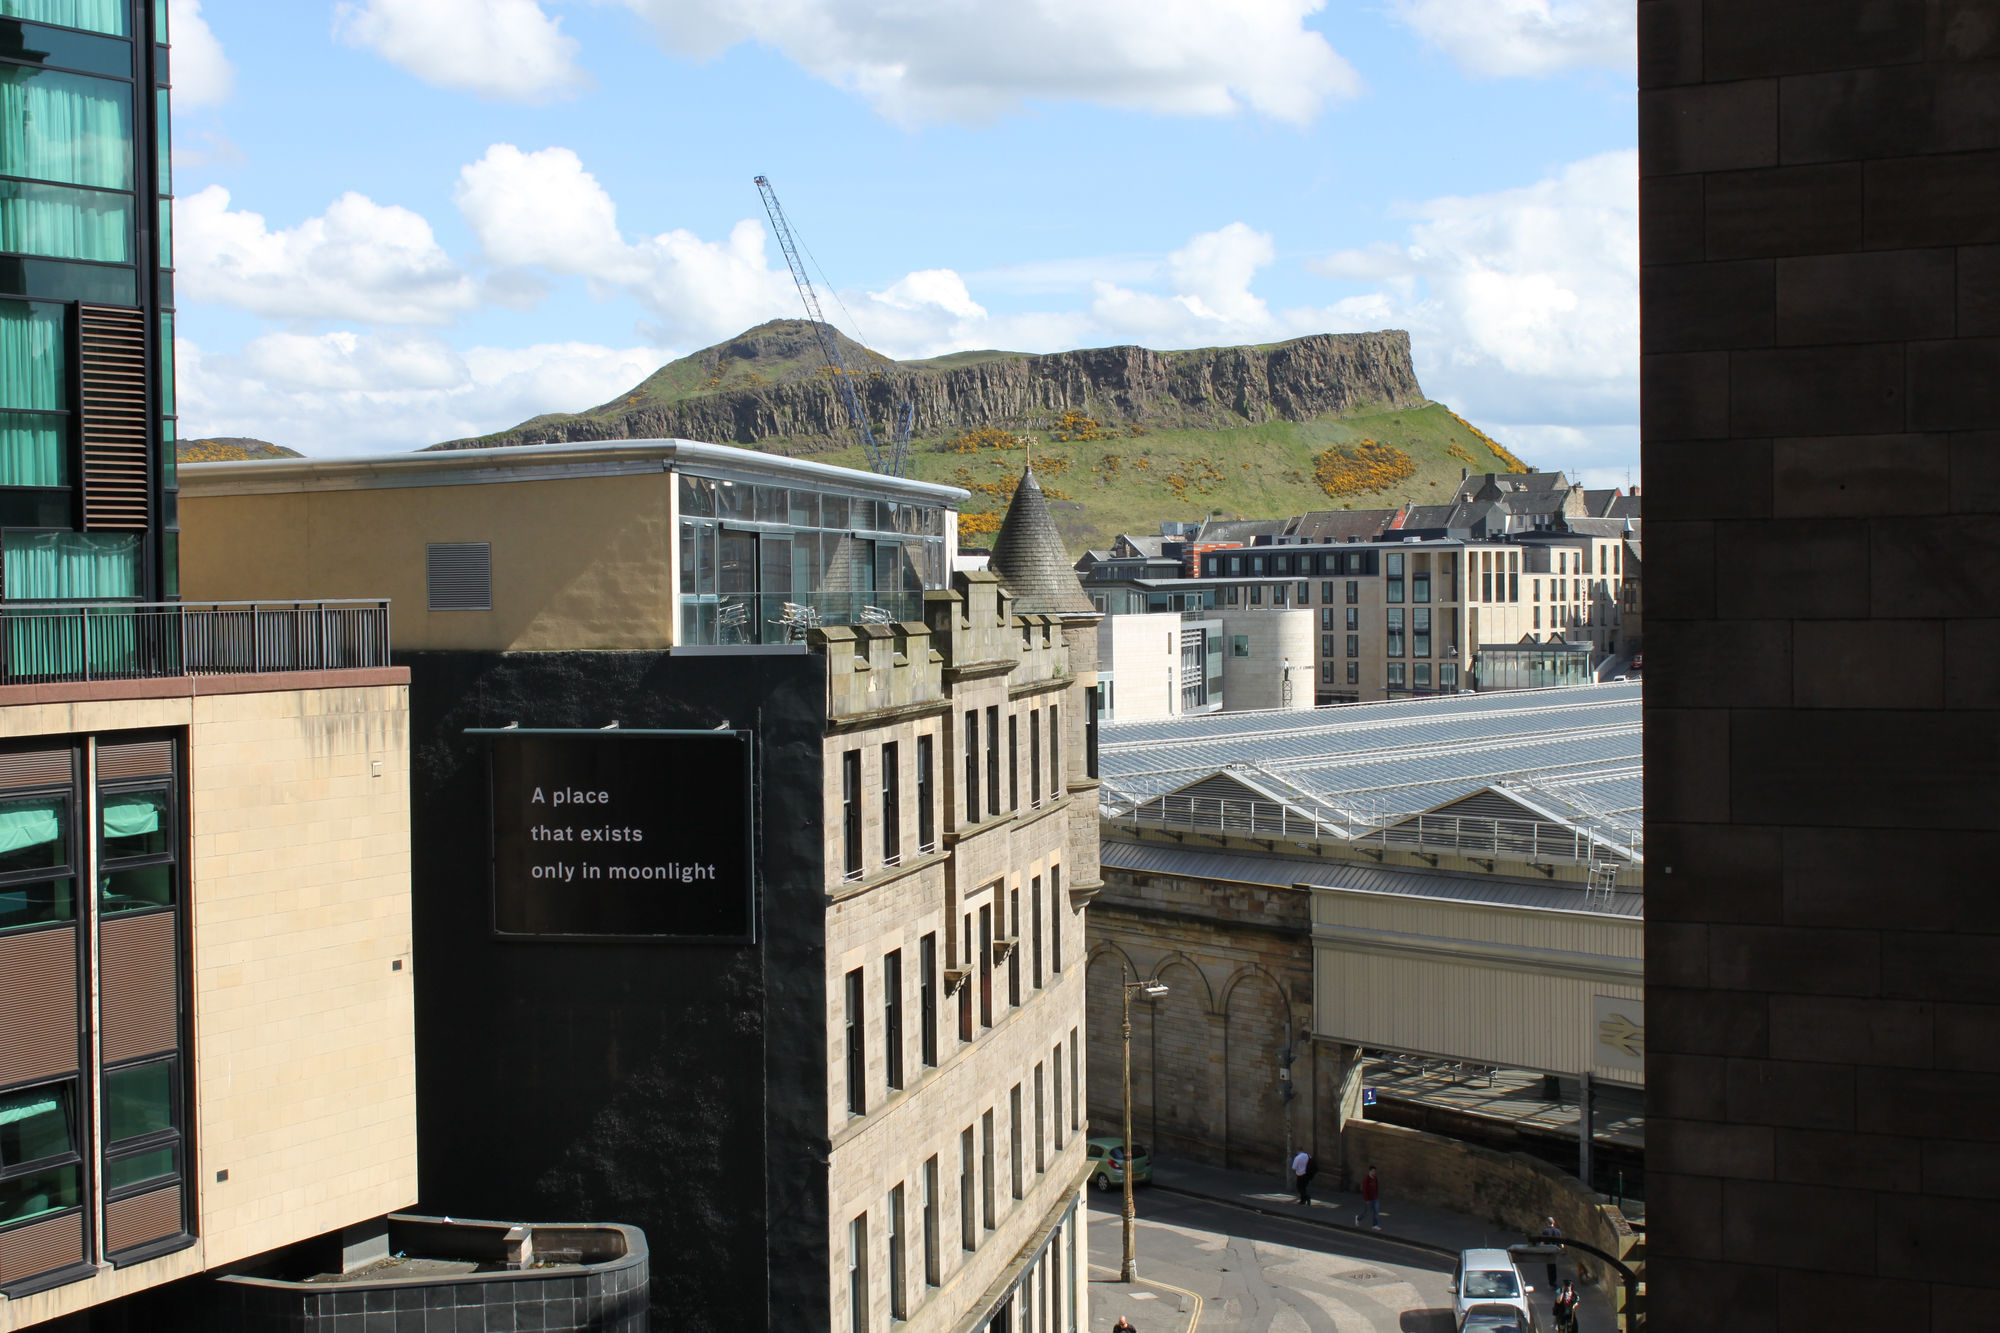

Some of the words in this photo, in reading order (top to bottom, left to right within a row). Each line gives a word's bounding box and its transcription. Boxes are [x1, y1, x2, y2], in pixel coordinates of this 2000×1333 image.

[531, 786, 546, 804] A
[553, 786, 609, 807] place
[530, 825, 573, 842] that
[580, 825, 643, 842] exists
[531, 861, 575, 883] only
[582, 862, 601, 879] in
[609, 862, 716, 883] moonlight
[1367, 1091, 1373, 1100] 1
